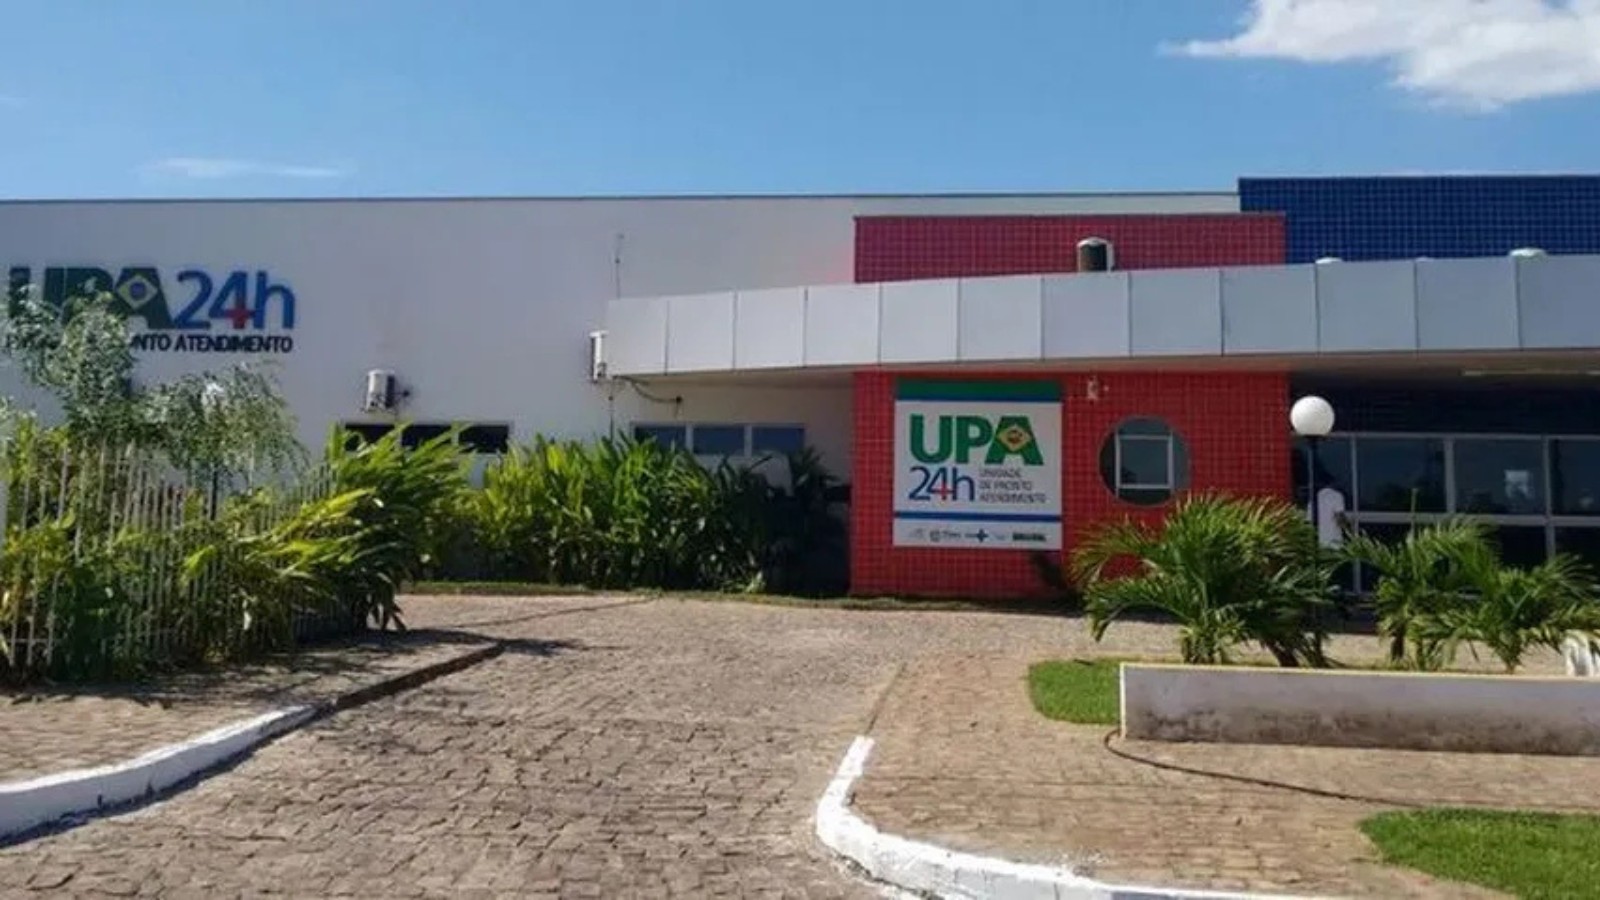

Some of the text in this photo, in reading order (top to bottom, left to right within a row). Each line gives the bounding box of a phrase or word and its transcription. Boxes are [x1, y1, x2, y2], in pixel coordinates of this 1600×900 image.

[8, 267, 296, 330] UPA 24h
[174, 334, 293, 353] ATENDIMENTO
[910, 414, 1044, 465] UPA
[909, 465, 975, 502] 24h
